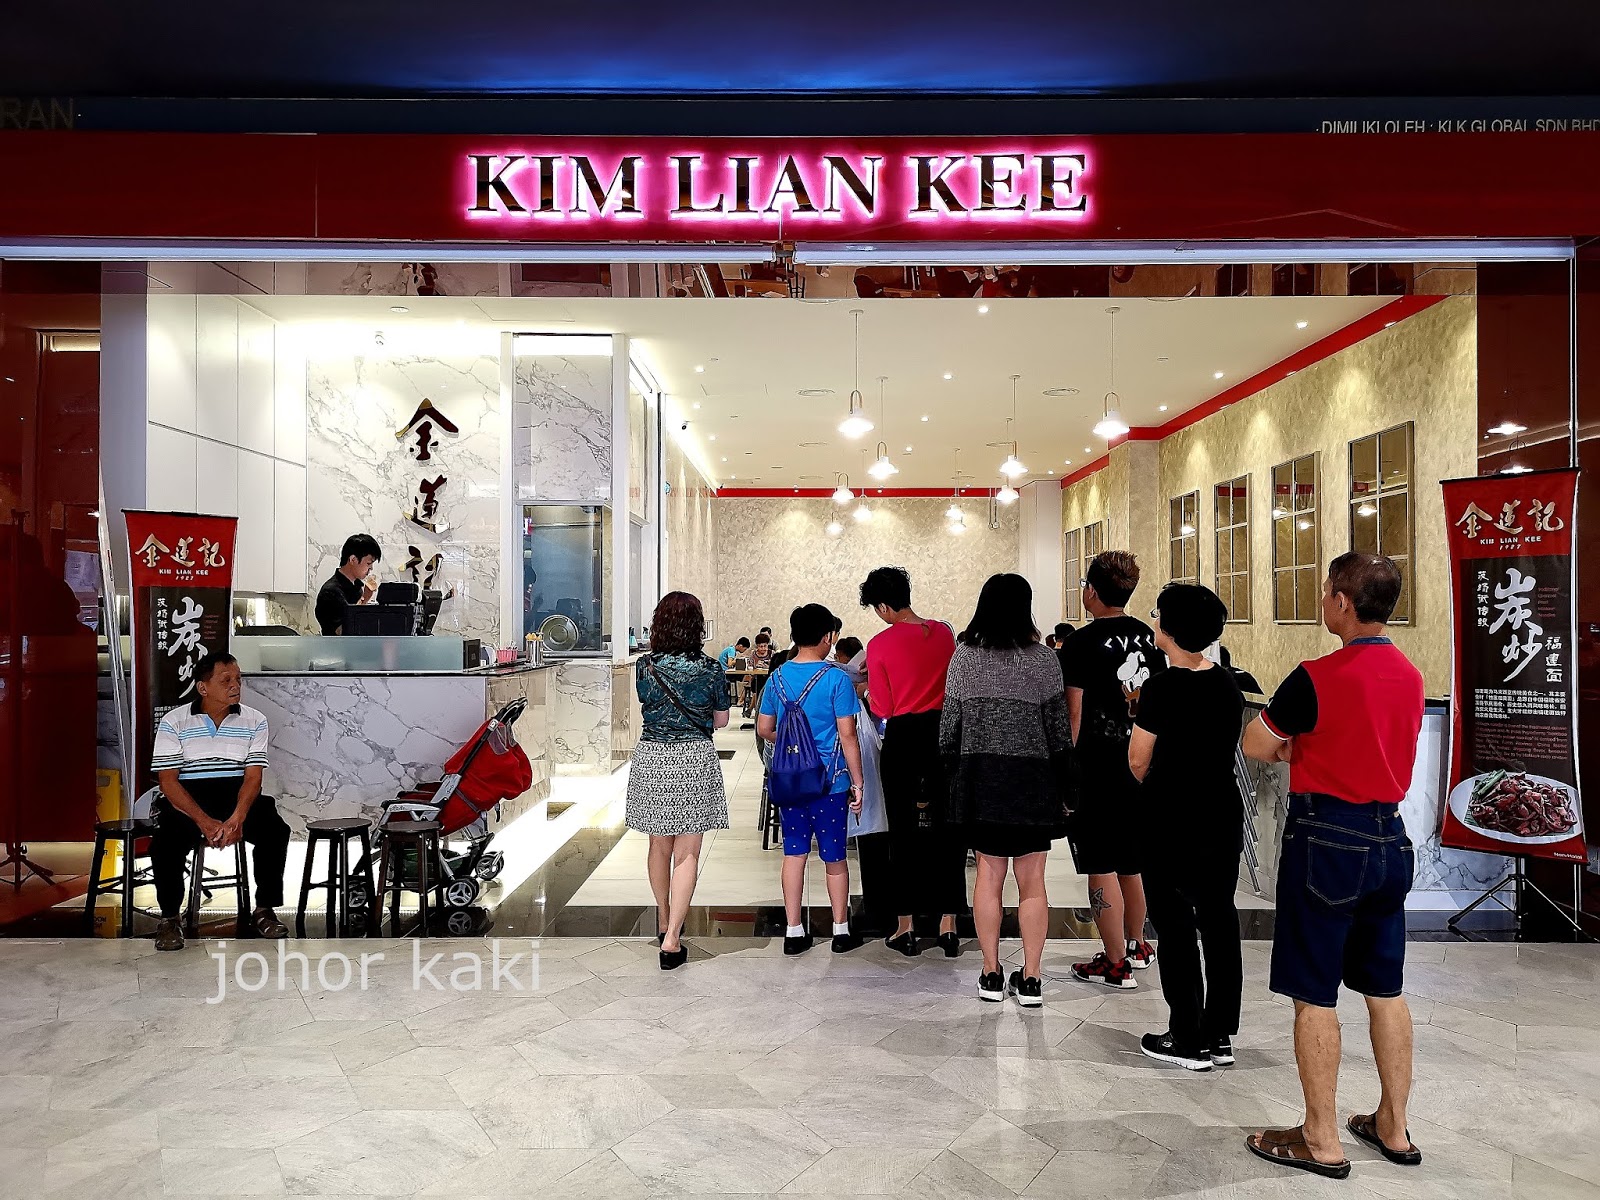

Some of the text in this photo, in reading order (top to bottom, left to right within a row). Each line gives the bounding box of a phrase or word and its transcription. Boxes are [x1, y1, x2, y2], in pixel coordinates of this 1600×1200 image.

[467, 153, 1087, 219] KIM LIAN KEE
[1545, 636, 1563, 682] 福建面
